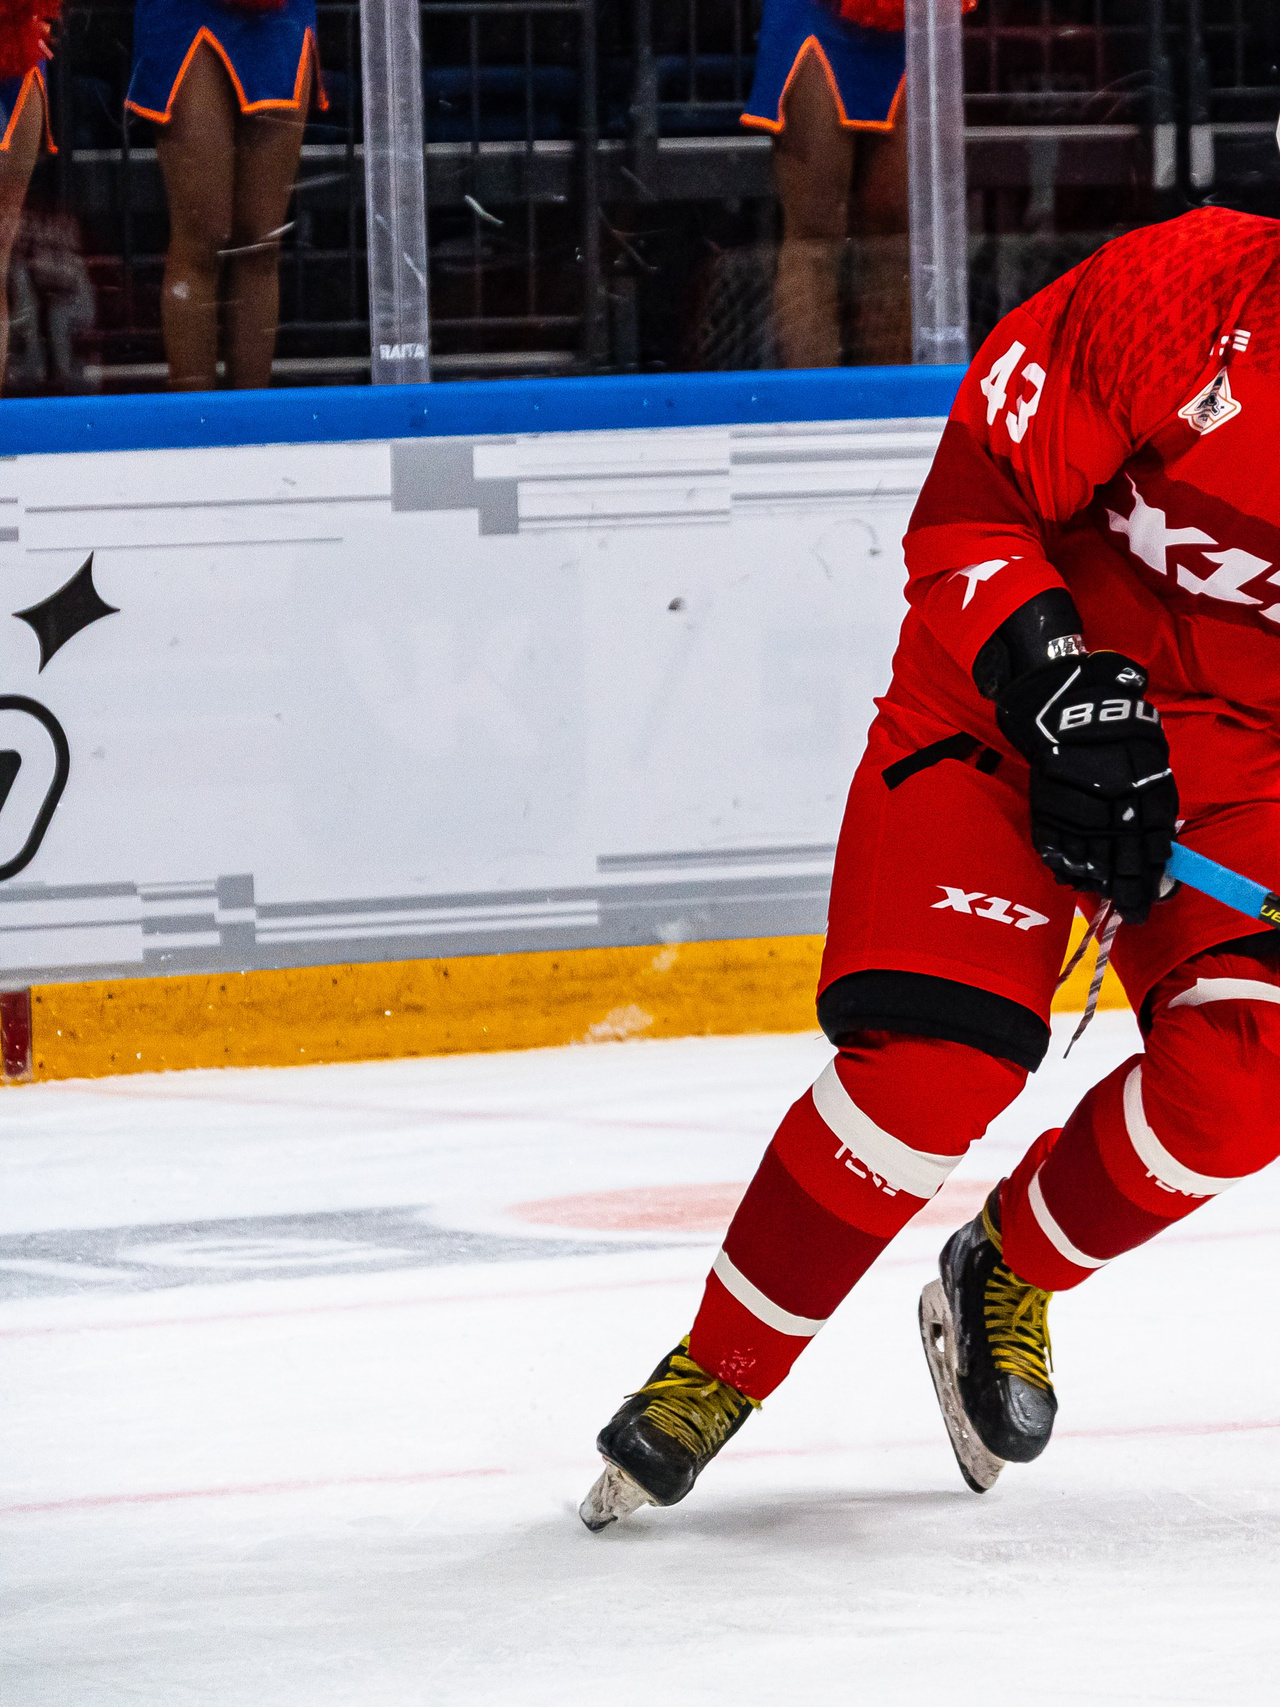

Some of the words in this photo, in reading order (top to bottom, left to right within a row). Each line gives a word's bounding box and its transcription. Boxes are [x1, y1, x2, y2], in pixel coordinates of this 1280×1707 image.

[980, 340, 1047, 444] 43
[1058, 698, 1160, 732] BAU
[929, 885, 1051, 932] X17
